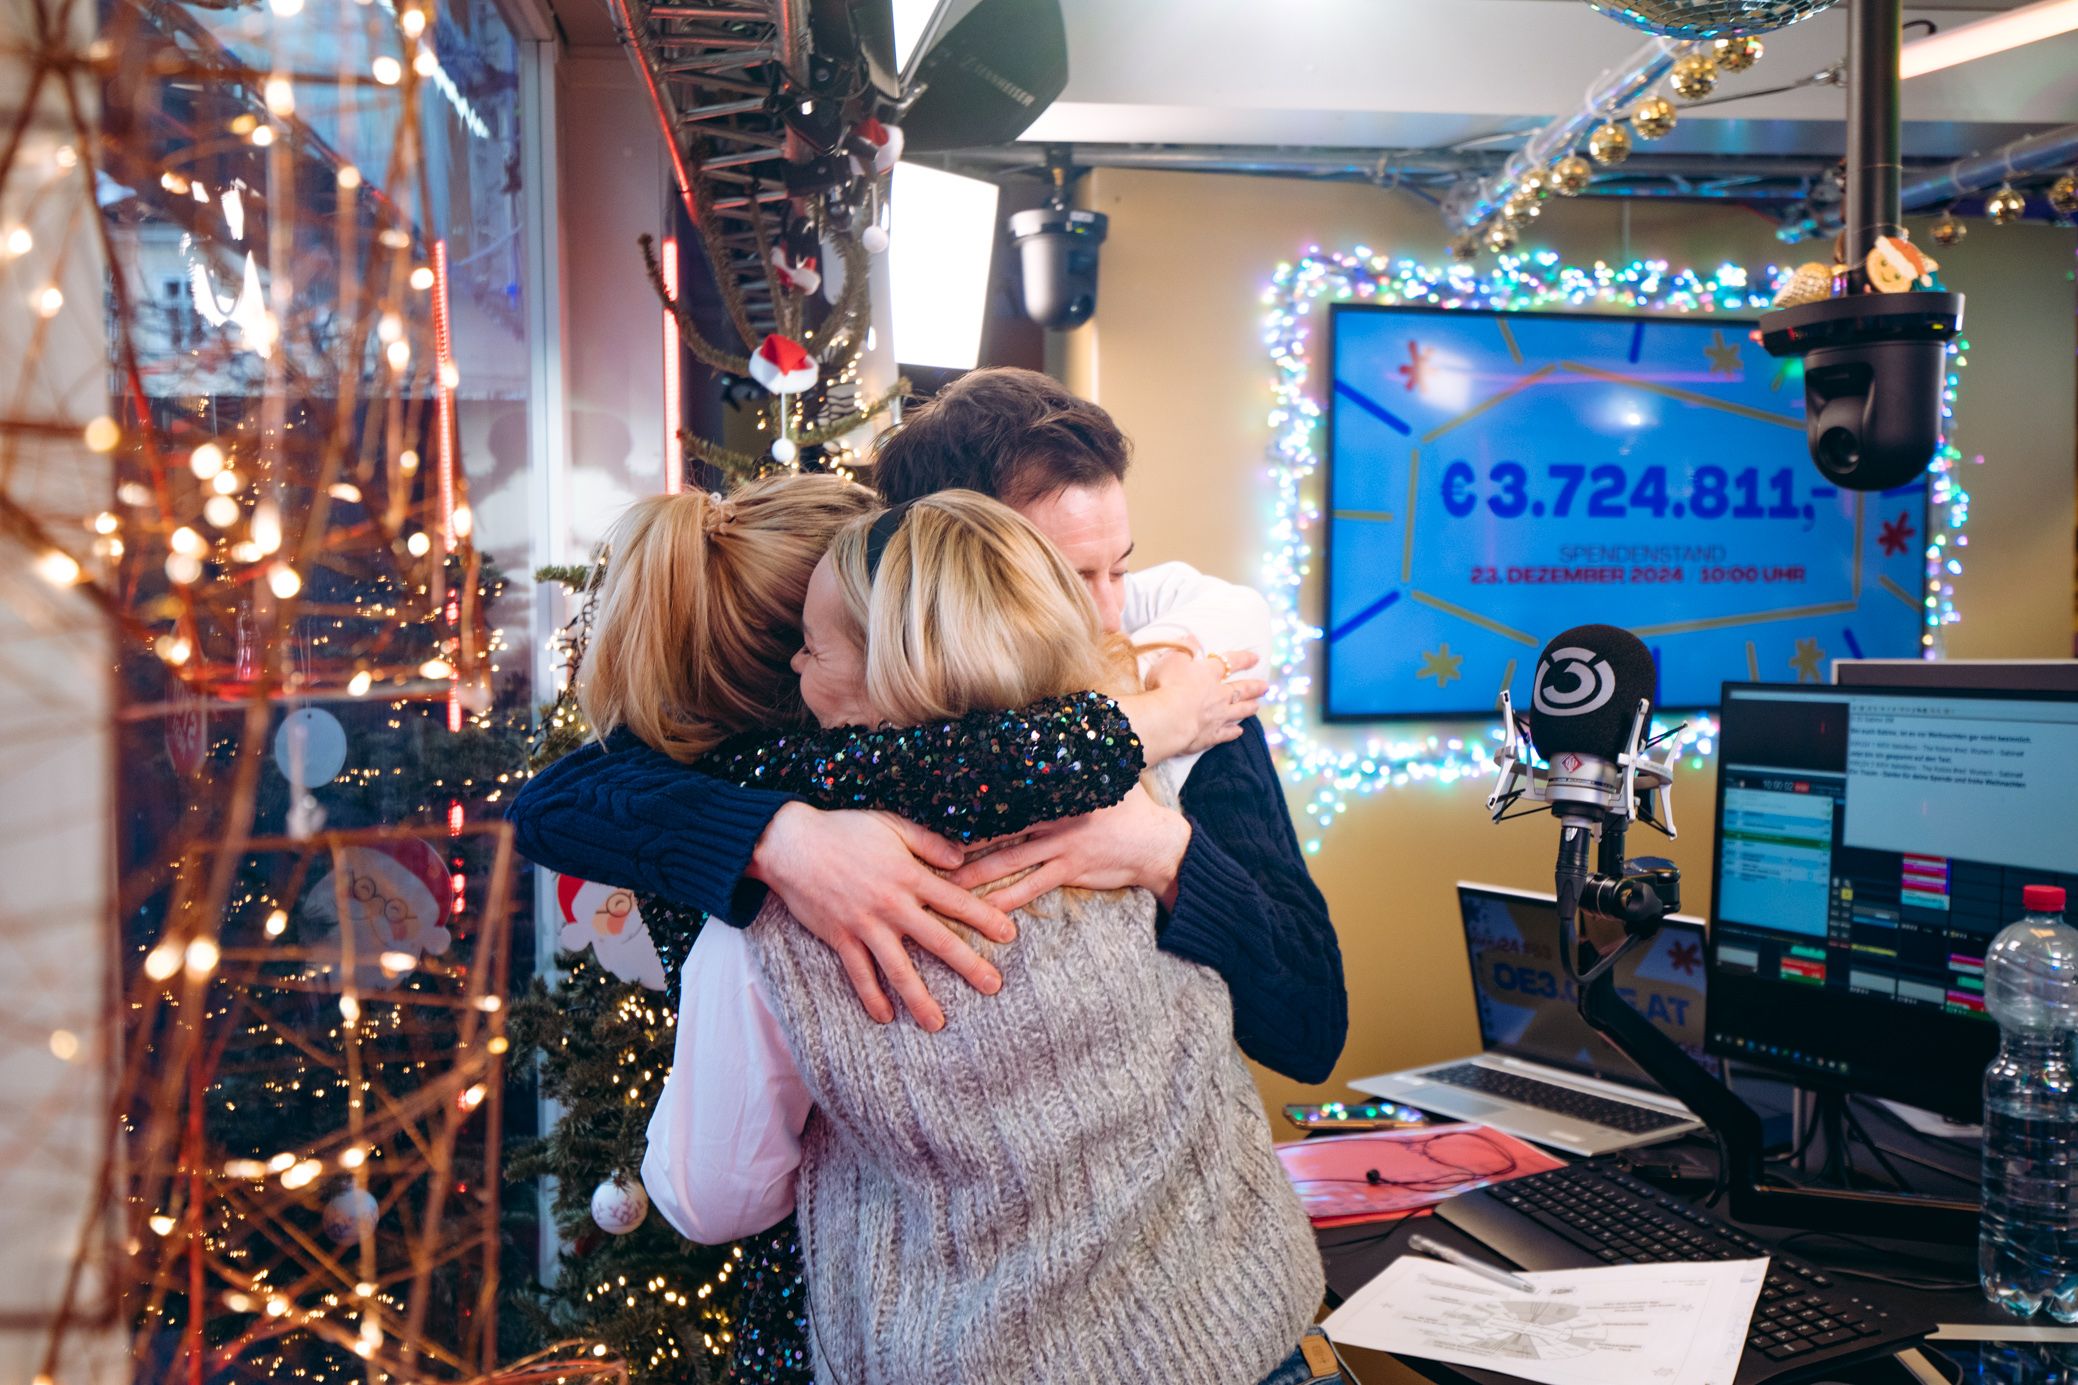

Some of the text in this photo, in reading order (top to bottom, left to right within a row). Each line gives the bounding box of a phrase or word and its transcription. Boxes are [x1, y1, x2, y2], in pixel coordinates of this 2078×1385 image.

[1559, 544, 1727, 563] SPENDENSTAND
[1507, 567, 1624, 584] DEZEMBER
[1630, 567, 1684, 584] 2024
[1700, 567, 1759, 584] 10:00
[1762, 566, 1806, 584] UHR
